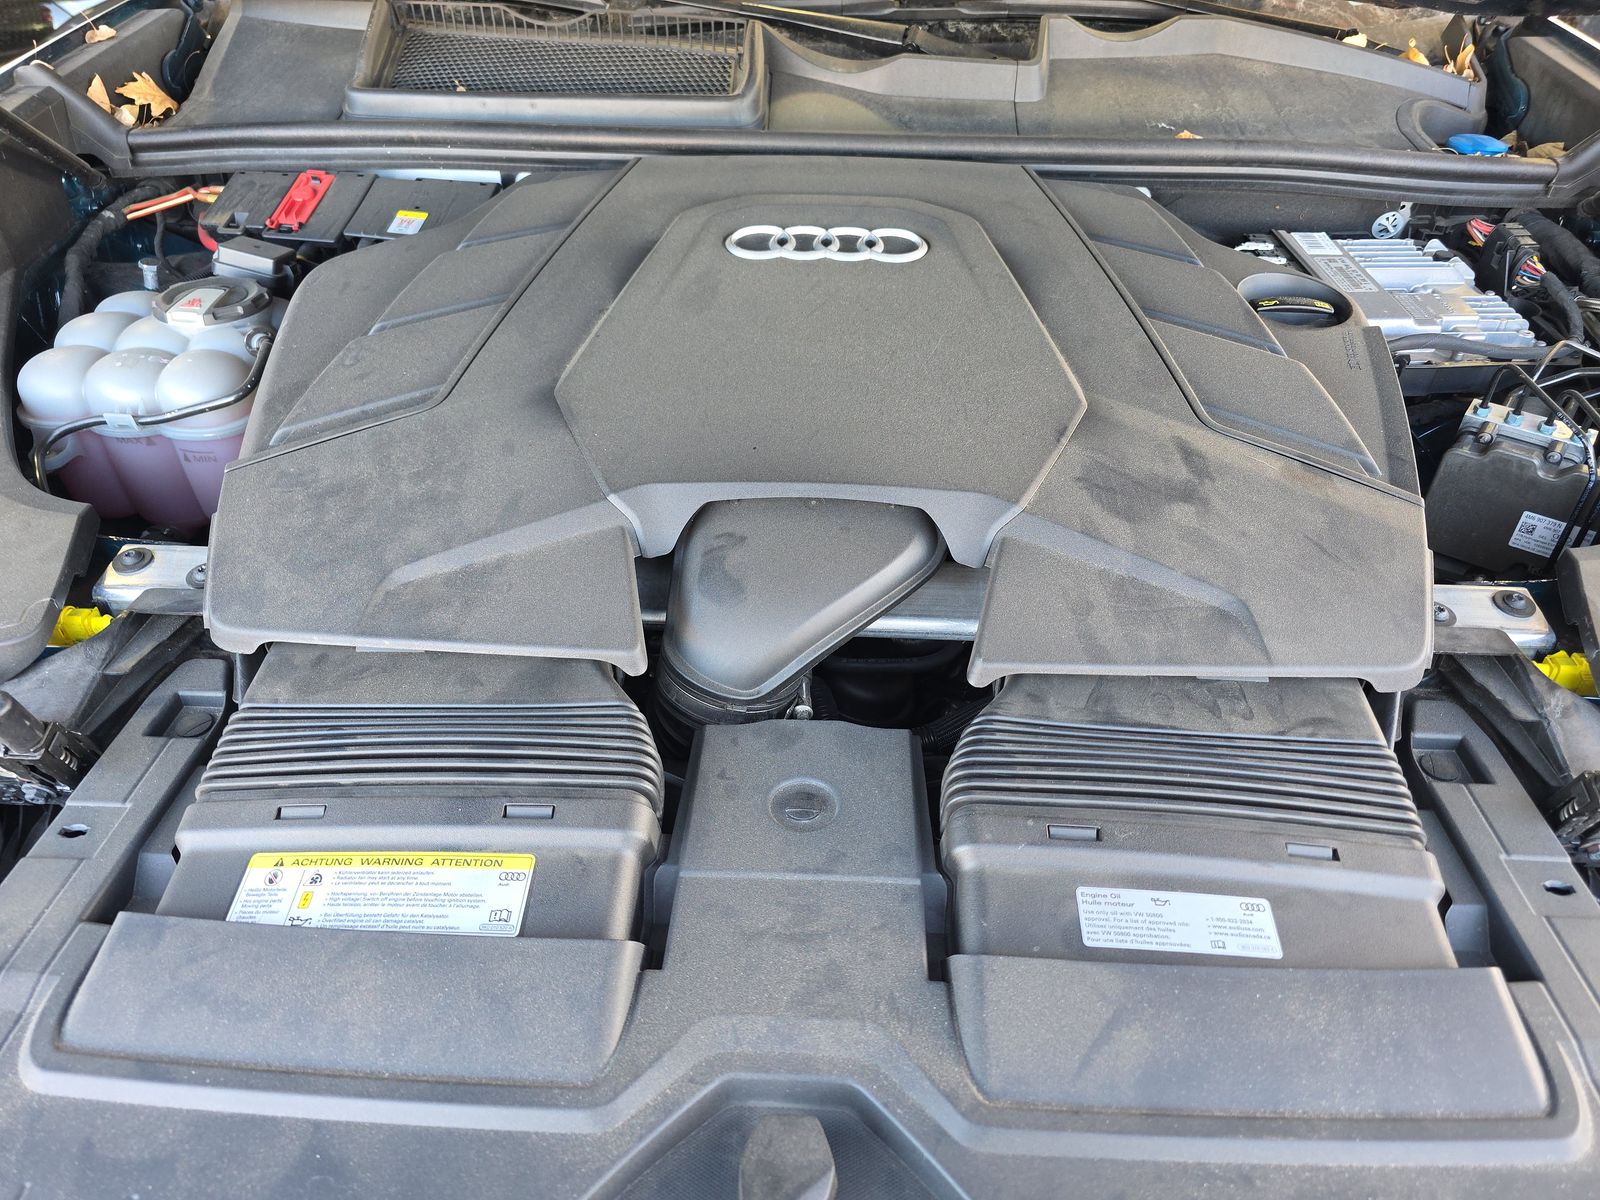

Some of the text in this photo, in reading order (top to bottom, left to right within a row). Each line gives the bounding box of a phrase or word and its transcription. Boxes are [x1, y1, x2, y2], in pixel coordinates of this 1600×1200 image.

[192, 455, 217, 463] MIN
[291, 858, 503, 867] ACHTUNG WARNING ATTENTION
